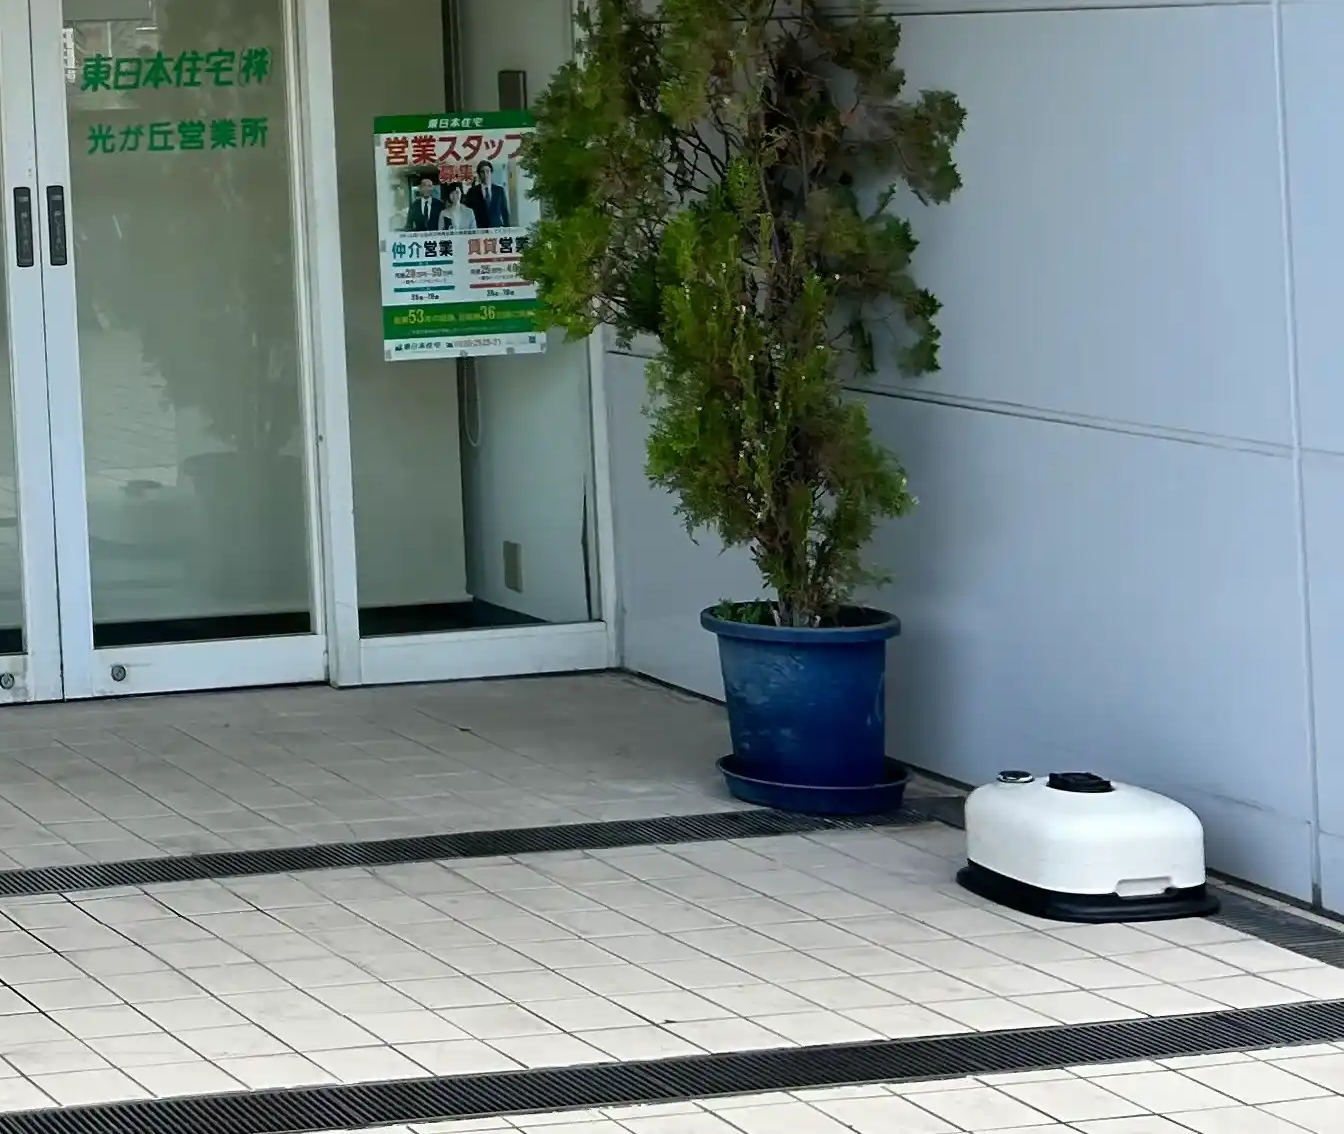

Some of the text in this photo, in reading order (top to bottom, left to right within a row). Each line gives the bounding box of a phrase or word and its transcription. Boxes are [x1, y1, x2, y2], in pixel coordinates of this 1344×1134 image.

[428, 117, 483, 129] 東日本住宅
[87, 118, 268, 155] 光が丘営業所
[392, 239, 453, 259] 仲介営業
